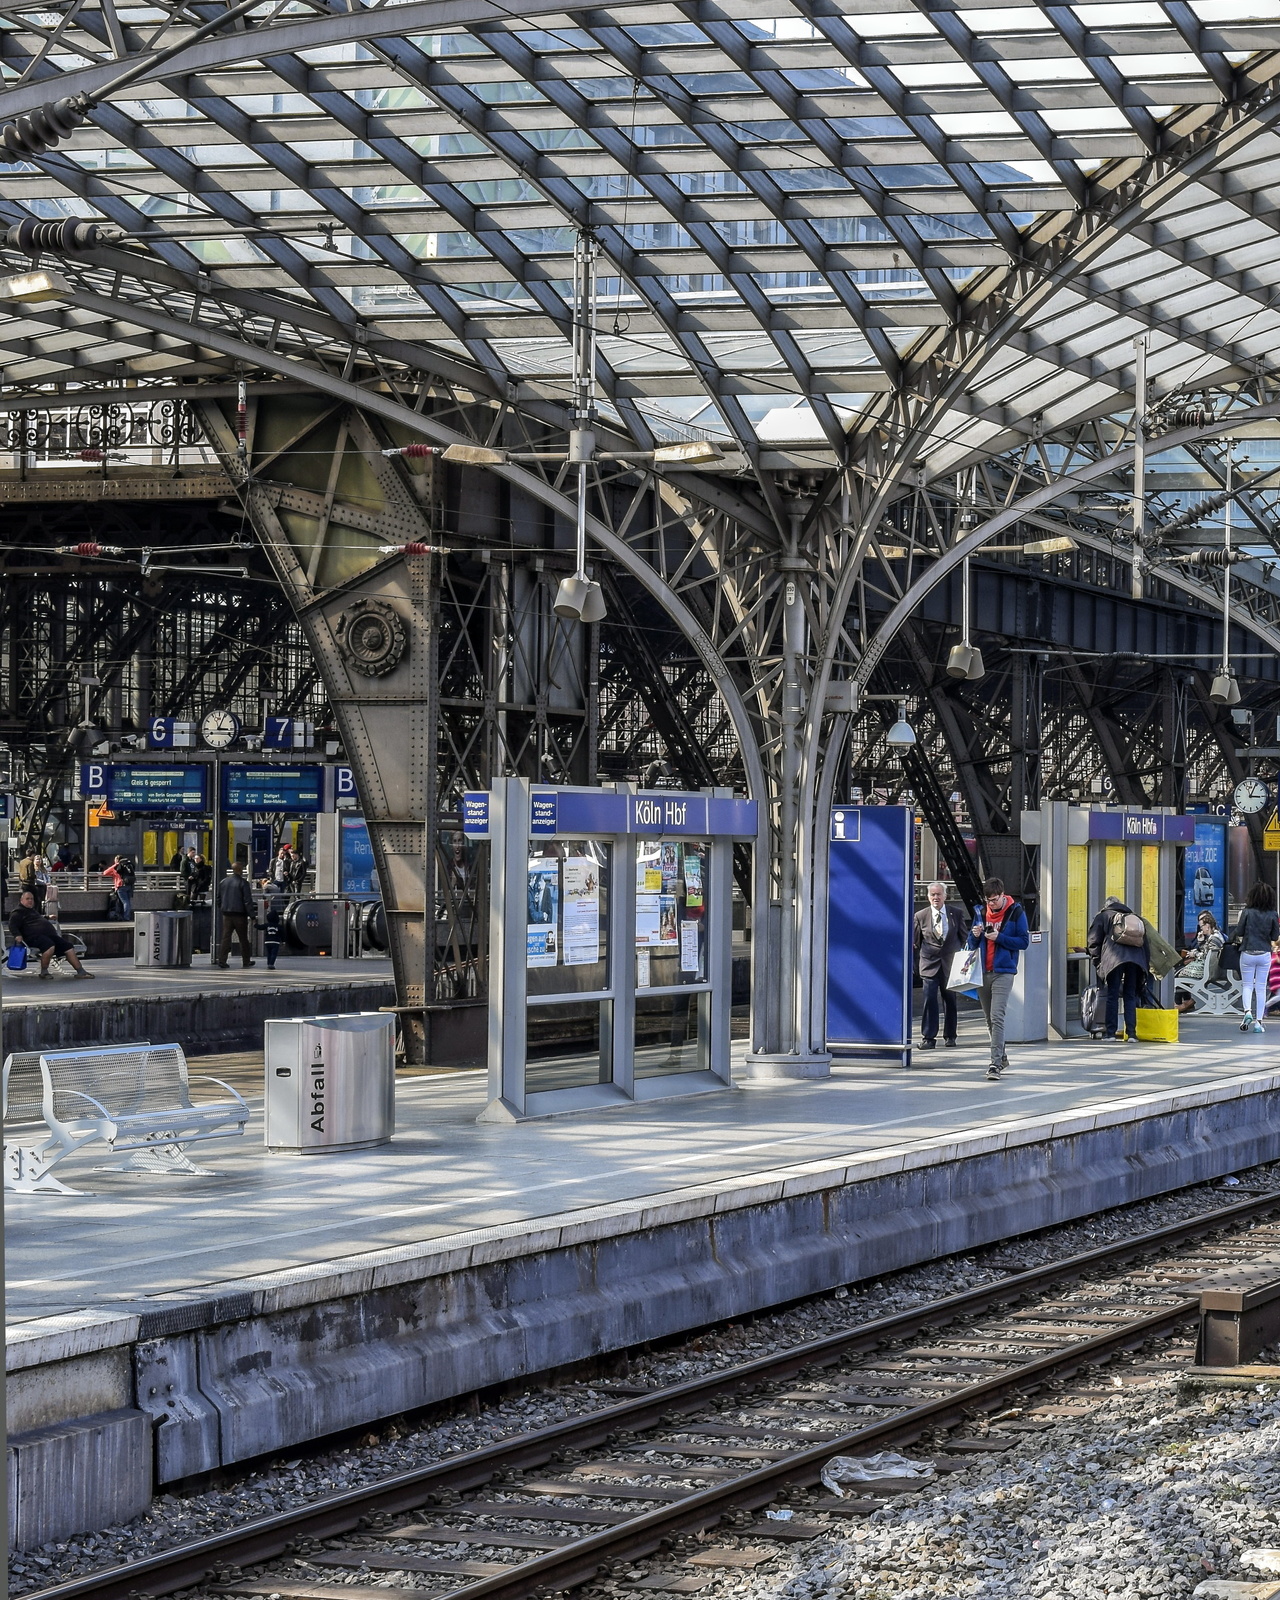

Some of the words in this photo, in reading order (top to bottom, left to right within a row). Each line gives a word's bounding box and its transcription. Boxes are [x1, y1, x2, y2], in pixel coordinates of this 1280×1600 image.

[152, 718, 165, 741] 6
[275, 718, 289, 741] 7
[89, 765, 104, 788] B
[338, 768, 354, 792] B
[1104, 776, 1113, 790] 6
[150, 780, 172, 788] gesperrt
[465, 801, 488, 809] Wagen-
[533, 801, 556, 809] Wagen-
[1215, 804, 1226, 817] C
[635, 800, 661, 824] Köln
[665, 801, 687, 826] Hbf
[464, 817, 489, 825] anzeiger
[532, 818, 556, 826] anzeiger
[1127, 817, 1142, 834] Köln
[1142, 818, 1154, 835] Hbf
[354, 840, 373, 854] Ren
[1205, 847, 1218, 862] ZOE
[361, 880, 366, 890] €
[310, 1064, 325, 1133] Abfall
